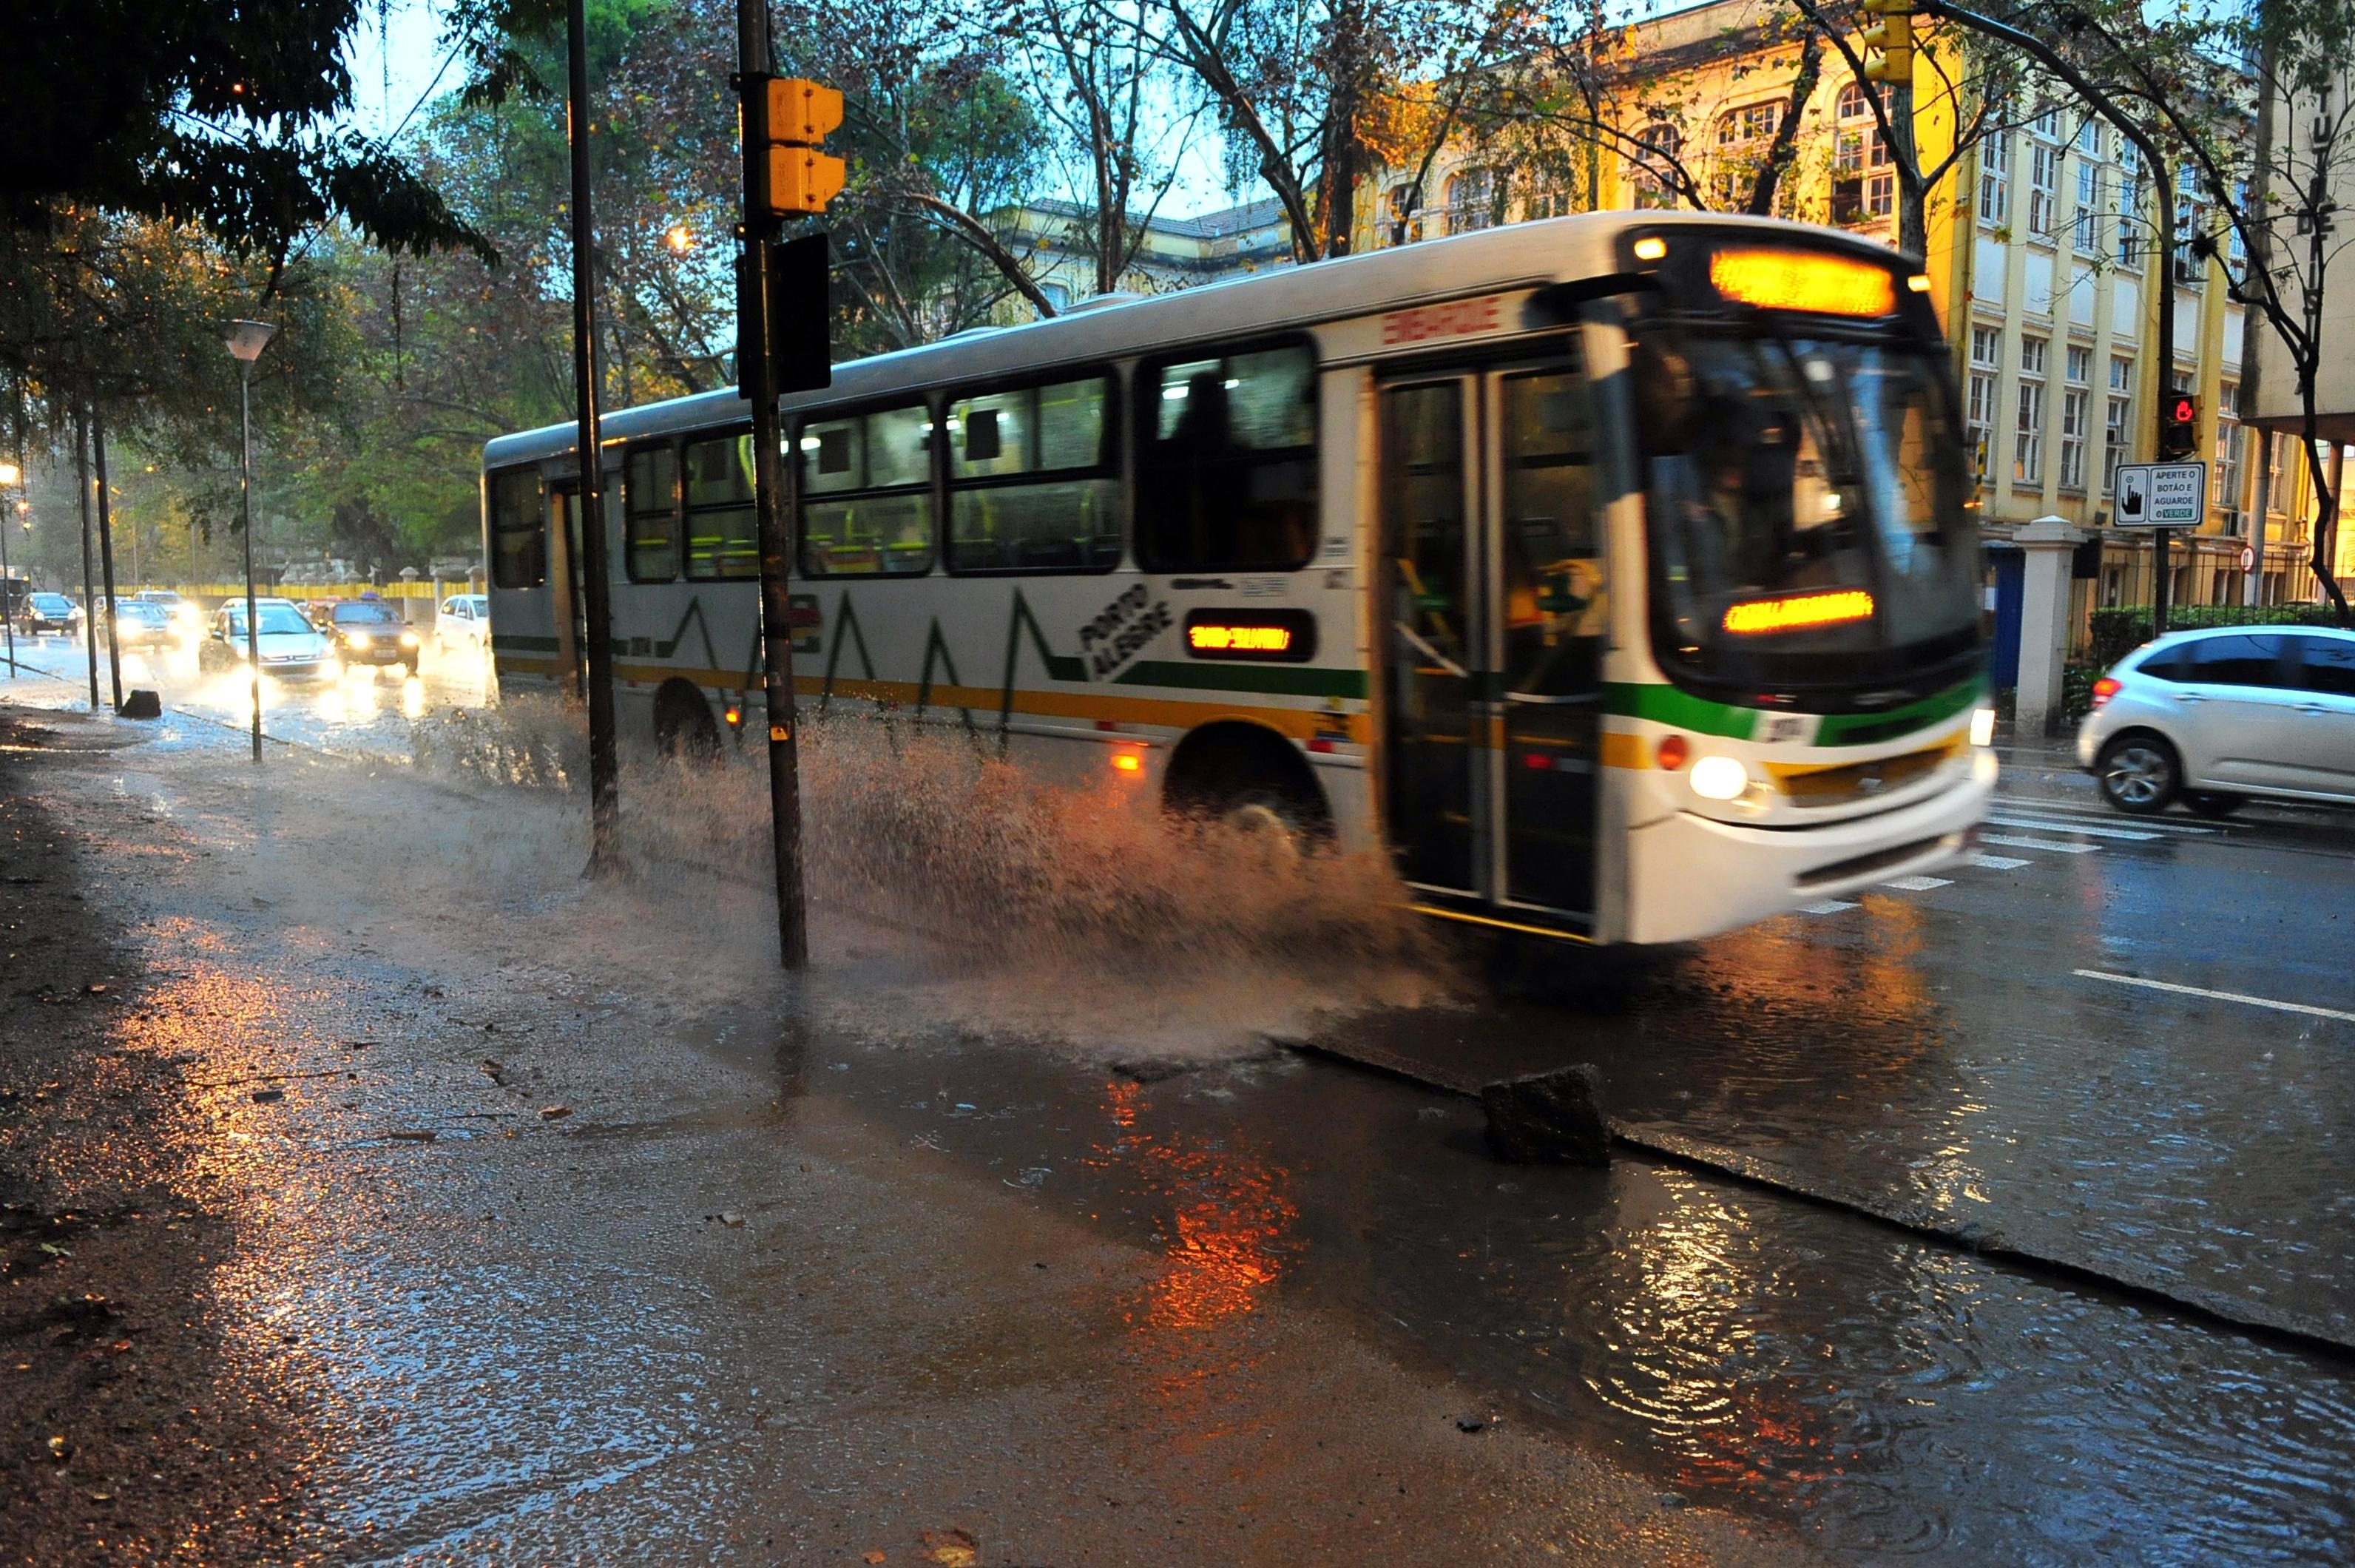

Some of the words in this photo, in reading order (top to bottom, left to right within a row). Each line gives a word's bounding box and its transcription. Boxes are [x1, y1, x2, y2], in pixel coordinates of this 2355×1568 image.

[2155, 470, 2187, 480] APERTE
[2189, 470, 2196, 479] O
[2157, 483, 2186, 492] BOTÃO
[2154, 496, 2194, 505] AGUARDE
[2163, 509, 2191, 518] VERDE
[1079, 583, 1149, 652] PORTO
[1092, 600, 1174, 680] ALEGRE
